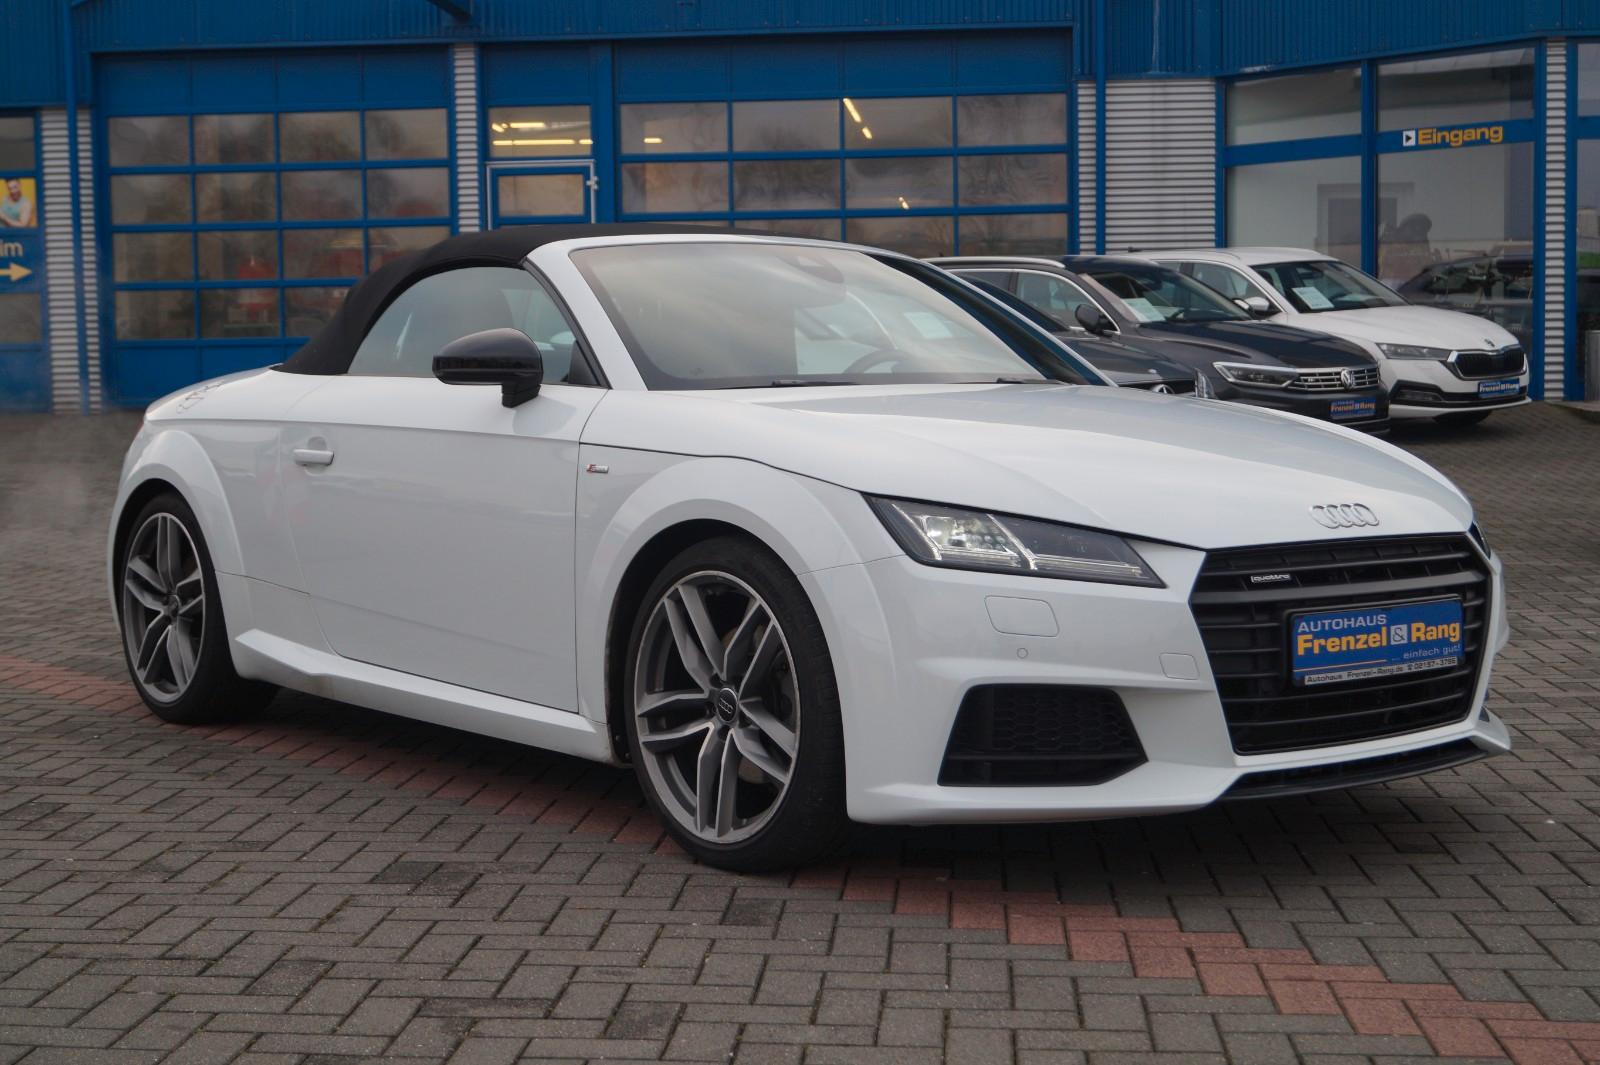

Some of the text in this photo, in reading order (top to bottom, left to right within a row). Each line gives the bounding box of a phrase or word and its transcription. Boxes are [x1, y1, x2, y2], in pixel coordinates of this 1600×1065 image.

[1418, 126, 1504, 147] Eingang
[1298, 614, 1387, 633] AUTOHAUS
[1297, 622, 1461, 655] Frenzel & Rang
[1403, 647, 1440, 659] einfach
